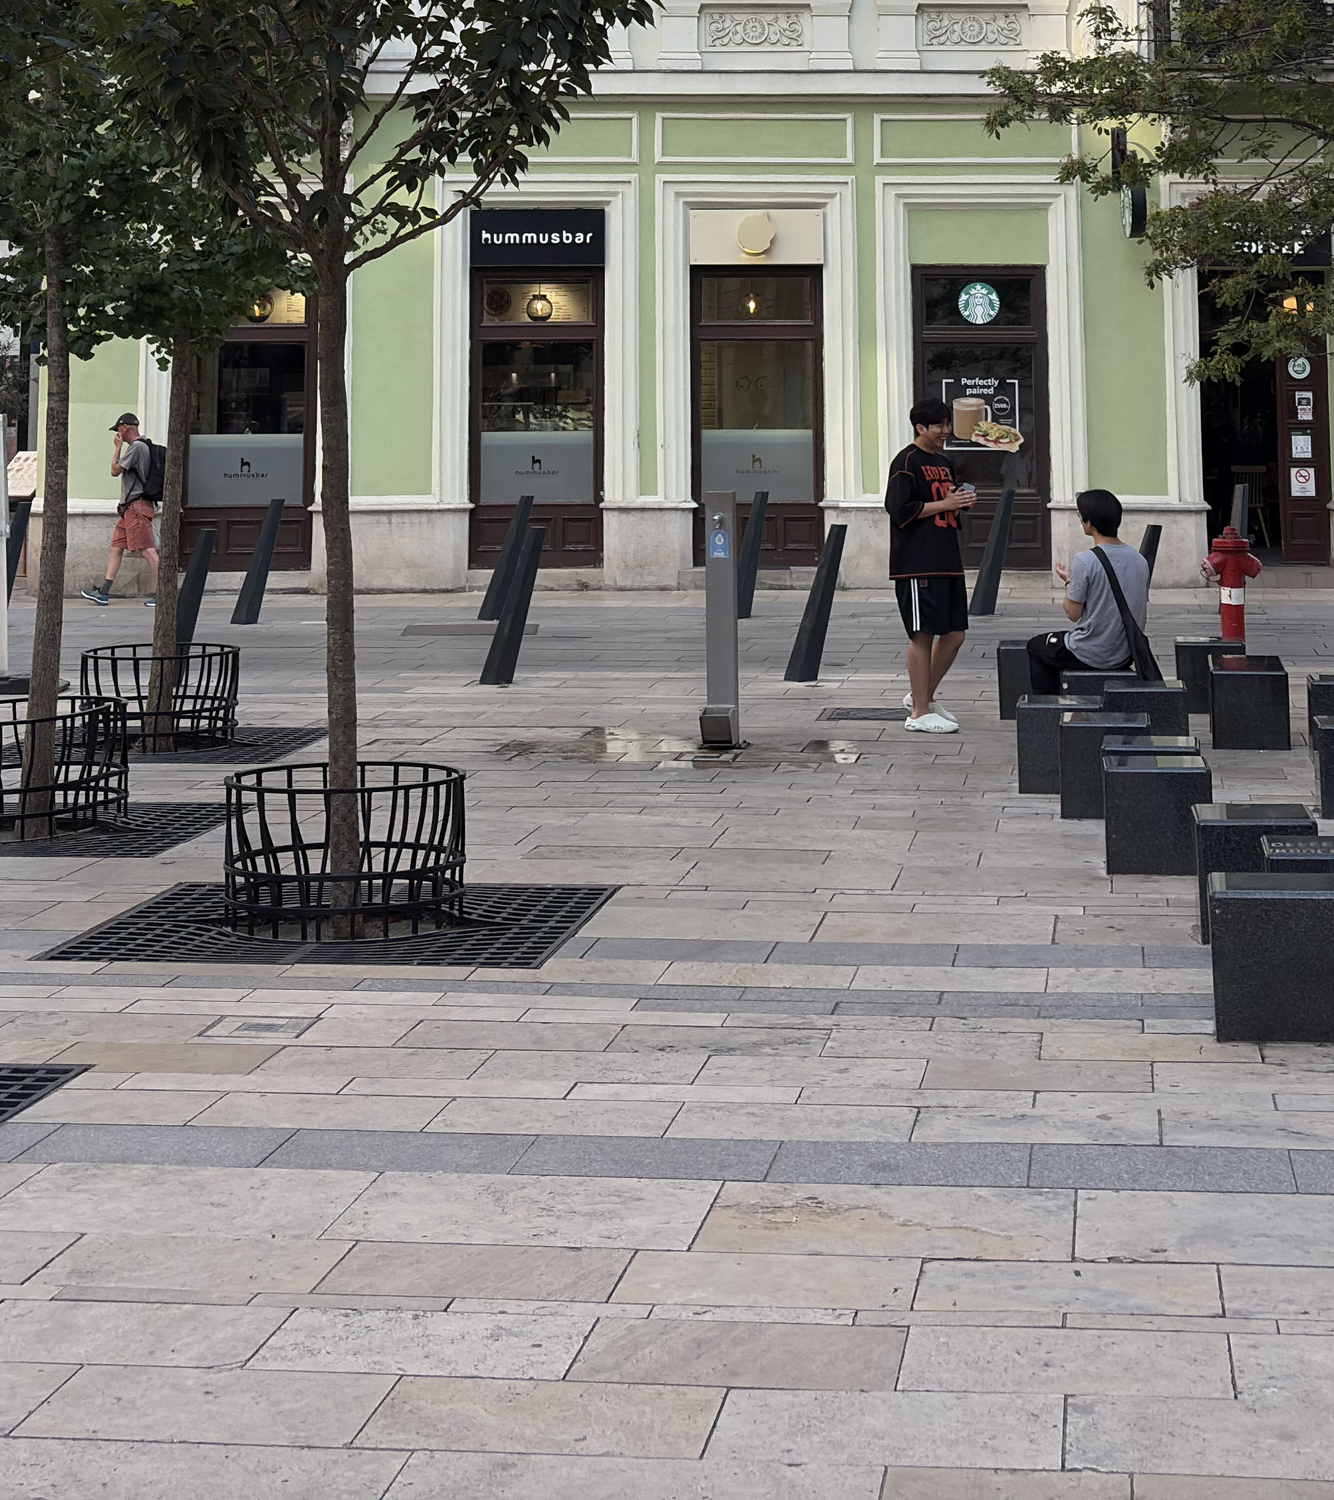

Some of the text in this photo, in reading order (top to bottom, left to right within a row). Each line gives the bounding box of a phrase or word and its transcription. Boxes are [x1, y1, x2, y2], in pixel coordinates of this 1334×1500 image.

[481, 229, 593, 244] hummusbar
[961, 377, 999, 387] Perfectly
[966, 386, 994, 395] paired
